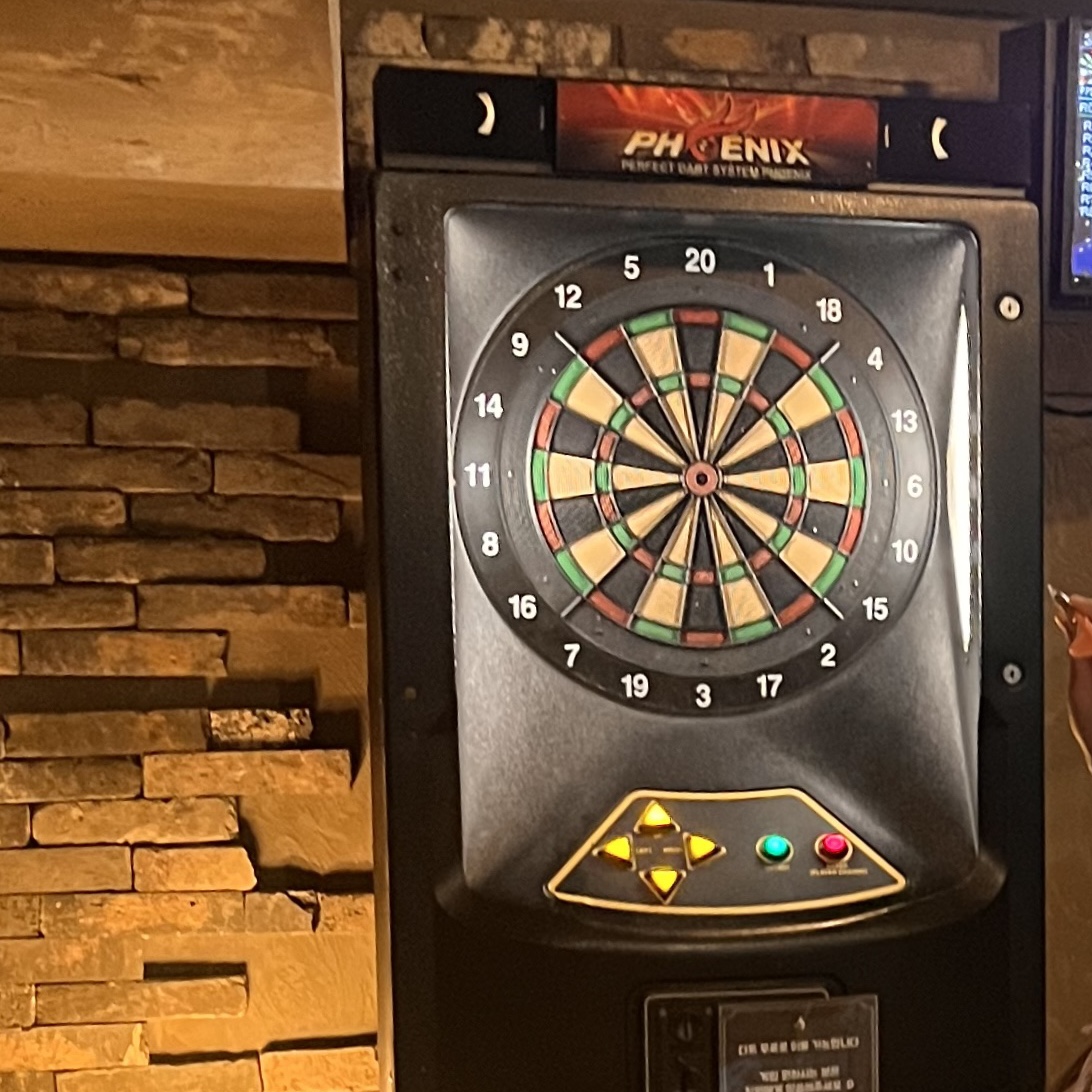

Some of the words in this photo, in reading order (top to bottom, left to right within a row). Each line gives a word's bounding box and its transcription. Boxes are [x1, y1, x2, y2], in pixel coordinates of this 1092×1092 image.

[623, 129, 811, 166] PHOENIX
[623, 254, 640, 280] 5
[685, 247, 716, 274] 20
[763, 262, 775, 287] 1
[554, 284, 582, 310] 12
[816, 297, 842, 323] 18
[511, 332, 529, 357] 9
[867, 346, 884, 371] 4
[474, 392, 503, 419] 14
[891, 409, 918, 434] 13
[463, 462, 491, 488] 11
[907, 474, 923, 499] 6
[481, 531, 499, 557] 8
[891, 538, 919, 564] 10
[508, 594, 537, 620] 16
[862, 596, 889, 621] 15
[563, 643, 581, 668] 7
[820, 643, 836, 667] 2
[621, 673, 649, 698] 19
[695, 683, 712, 708] 3
[756, 673, 783, 698] 17
